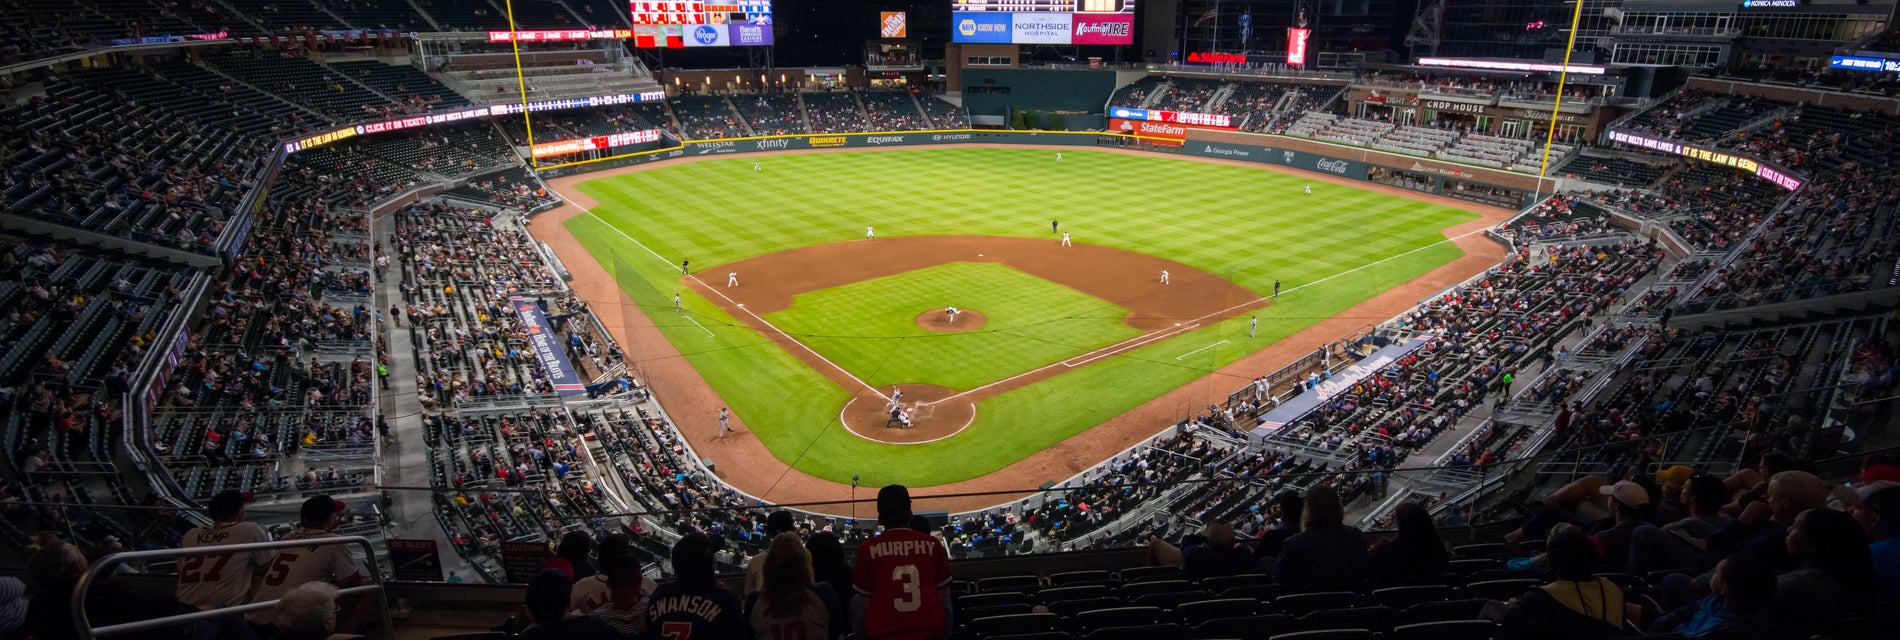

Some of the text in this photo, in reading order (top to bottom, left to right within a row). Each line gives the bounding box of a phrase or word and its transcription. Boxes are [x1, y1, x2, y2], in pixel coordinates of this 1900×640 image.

[881, 12, 904, 37] HOME
[961, 24, 975, 32] NAPA
[1101, 22, 1129, 36] TIRE
[696, 28, 716, 42] Kroger
[1885, 62, 1900, 70] 10:
[1454, 103, 1484, 112] HOUSE
[312, 136, 322, 145] THE
[366, 124, 385, 133] CLICK
[386, 122, 393, 130] IT
[403, 117, 426, 128] TICKET!
[756, 138, 788, 150] xfinity
[867, 136, 903, 144] EQUIFAX
[1213, 147, 1232, 156] Georgia
[1616, 133, 1628, 142] SEAT
[1628, 136, 1643, 145] BELTS
[1644, 138, 1658, 148] SAVE
[1658, 142, 1674, 152] LIVES
[1676, 145, 1681, 154] &
[1683, 146, 1690, 155] IT
[1690, 148, 1698, 157] IS
[1699, 150, 1712, 160] THE
[1712, 153, 1728, 164] LAW
[1728, 156, 1738, 166] IN
[197, 532, 229, 544] KEMP
[406, 541, 433, 549] ALERT
[505, 544, 544, 553] CAUTION
[870, 540, 935, 559] MURPHY
[181, 551, 234, 584] 27
[265, 553, 298, 586] 5
[892, 564, 921, 612] 3
[650, 594, 722, 622] SWANSON
[662, 621, 692, 640] 7
